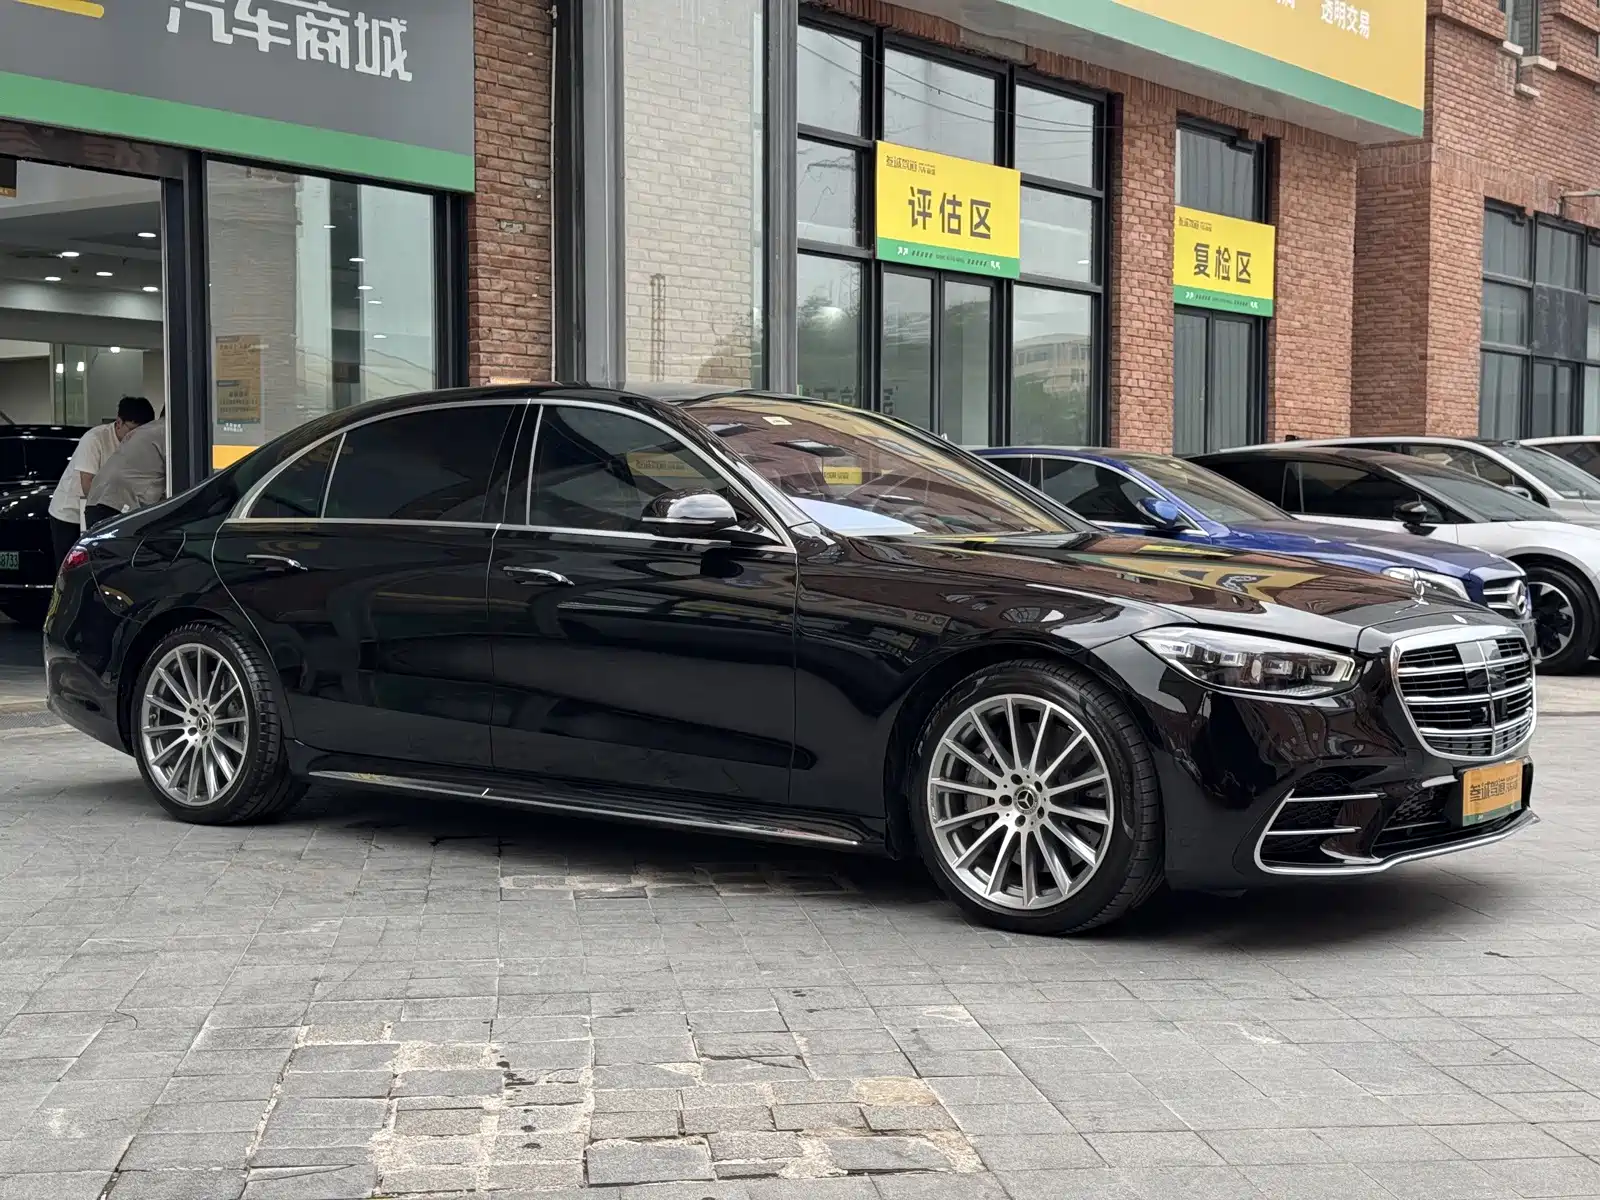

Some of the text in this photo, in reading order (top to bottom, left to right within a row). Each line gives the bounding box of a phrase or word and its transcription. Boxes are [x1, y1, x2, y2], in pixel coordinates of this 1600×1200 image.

[167, 0, 413, 82] 汽车商城
[1320, 0, 1370, 40] 透明交易
[907, 186, 992, 240] 评估区
[1193, 242, 1252, 284] 复检区
